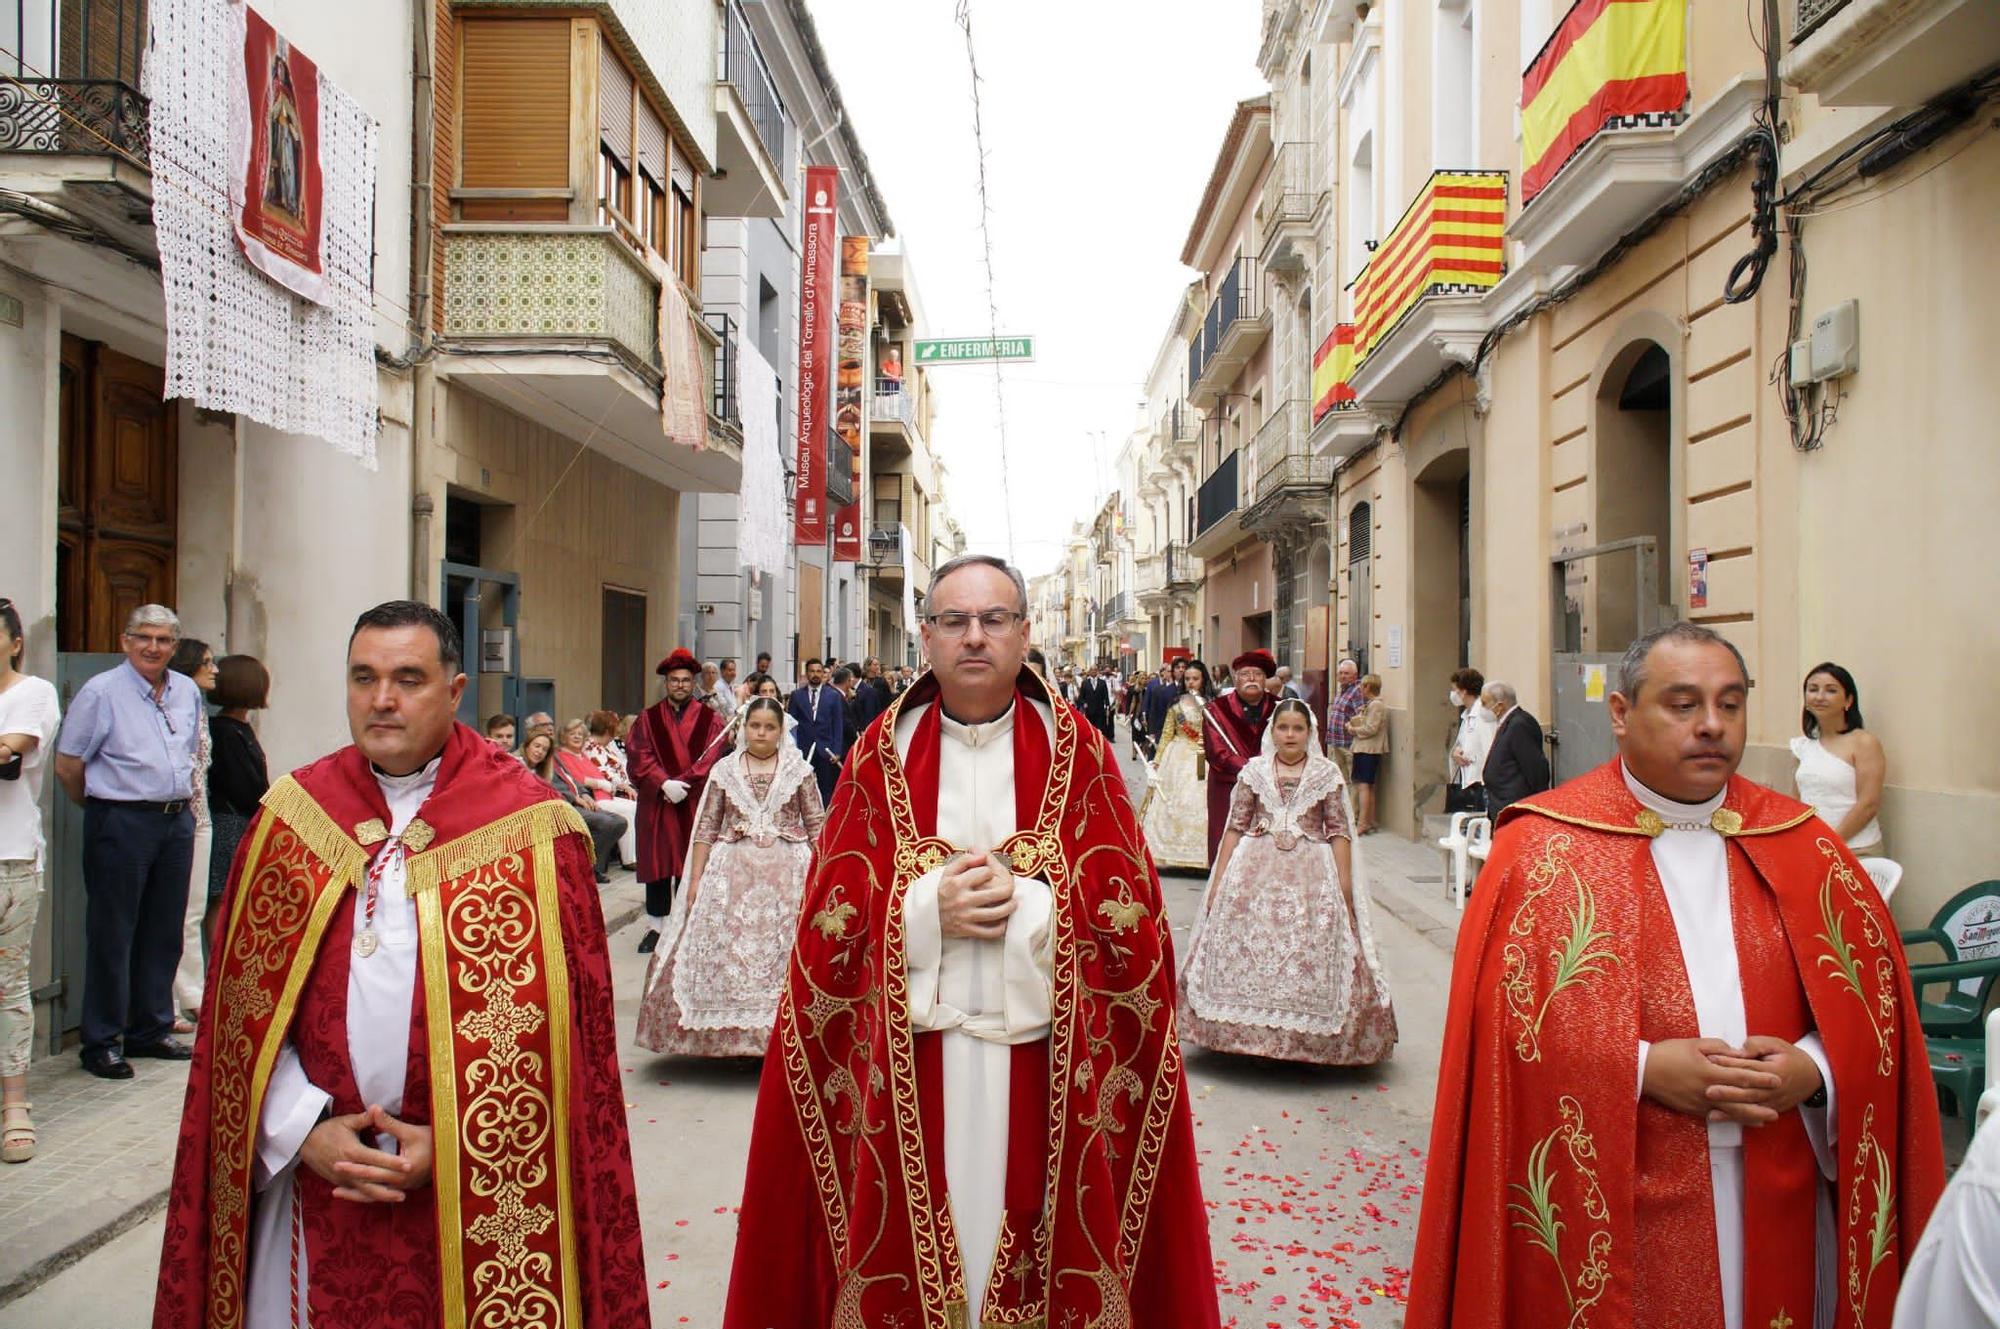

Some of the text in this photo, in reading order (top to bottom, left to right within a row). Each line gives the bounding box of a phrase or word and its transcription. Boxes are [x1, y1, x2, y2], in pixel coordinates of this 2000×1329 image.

[805, 224, 817, 299] d'Almassora
[803, 350, 812, 368] del
[940, 341, 1025, 358] ENFERMERIA
[801, 372, 814, 443] Arqueològic
[799, 447, 810, 489] Museu
